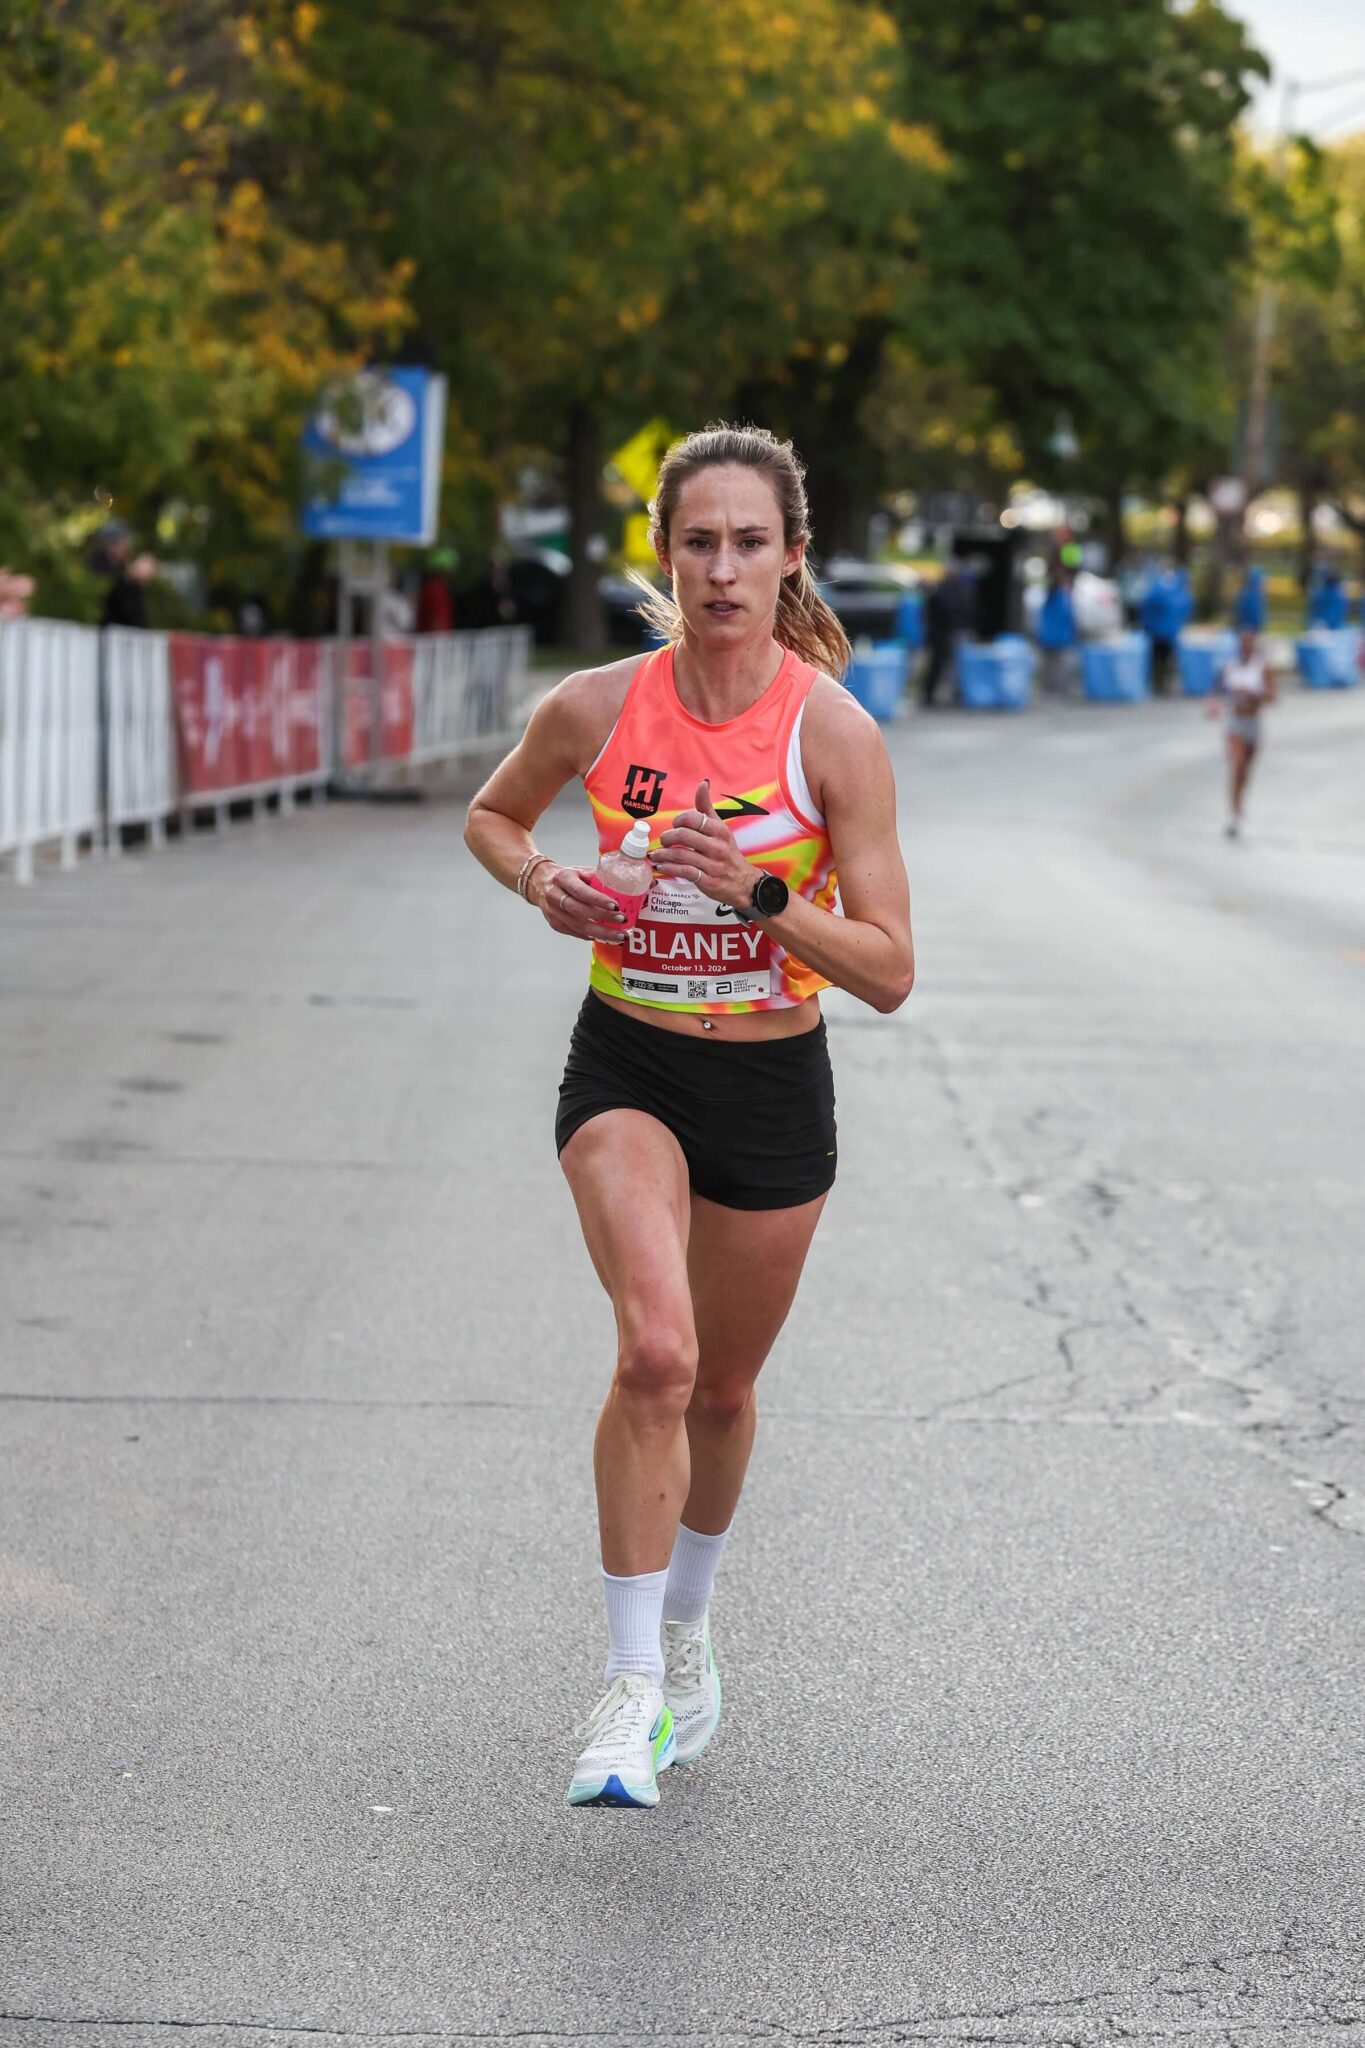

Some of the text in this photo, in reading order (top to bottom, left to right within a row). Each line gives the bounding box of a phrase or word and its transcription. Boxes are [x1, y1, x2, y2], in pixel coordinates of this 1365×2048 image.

[623, 800, 655, 812] HANSONS
[651, 896, 682, 908] Chicago
[650, 905, 689, 915] Marathon
[629, 928, 764, 961] BLANEY
[661, 963, 692, 972] October
[694, 965, 706, 973] 13,
